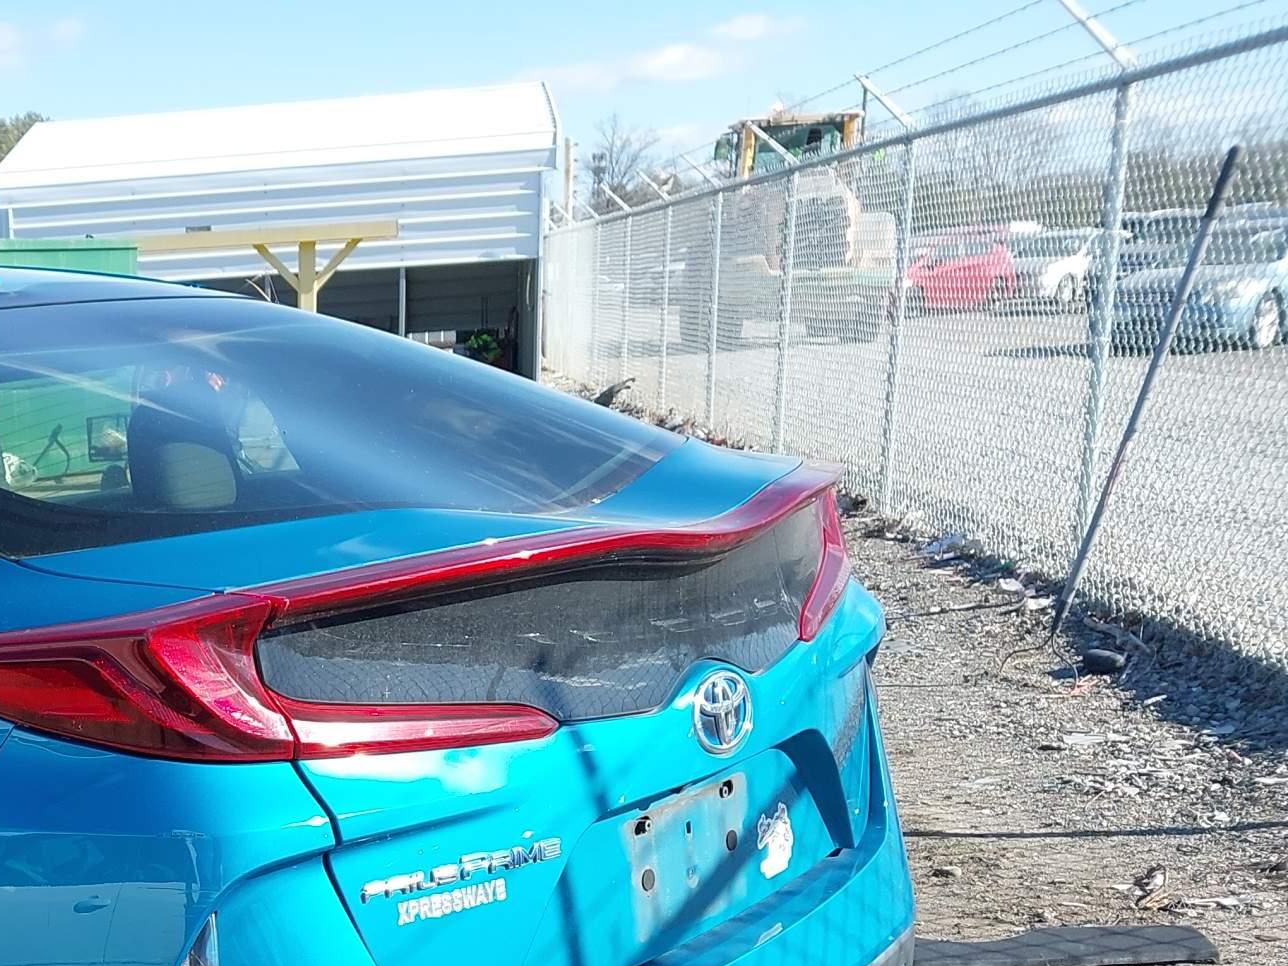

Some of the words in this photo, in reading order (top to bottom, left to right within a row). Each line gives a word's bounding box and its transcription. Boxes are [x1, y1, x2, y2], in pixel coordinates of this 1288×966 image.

[360, 863, 458, 904] PRIUS
[459, 837, 562, 880] PRIME
[397, 877, 507, 926] XPRESSWAYS
